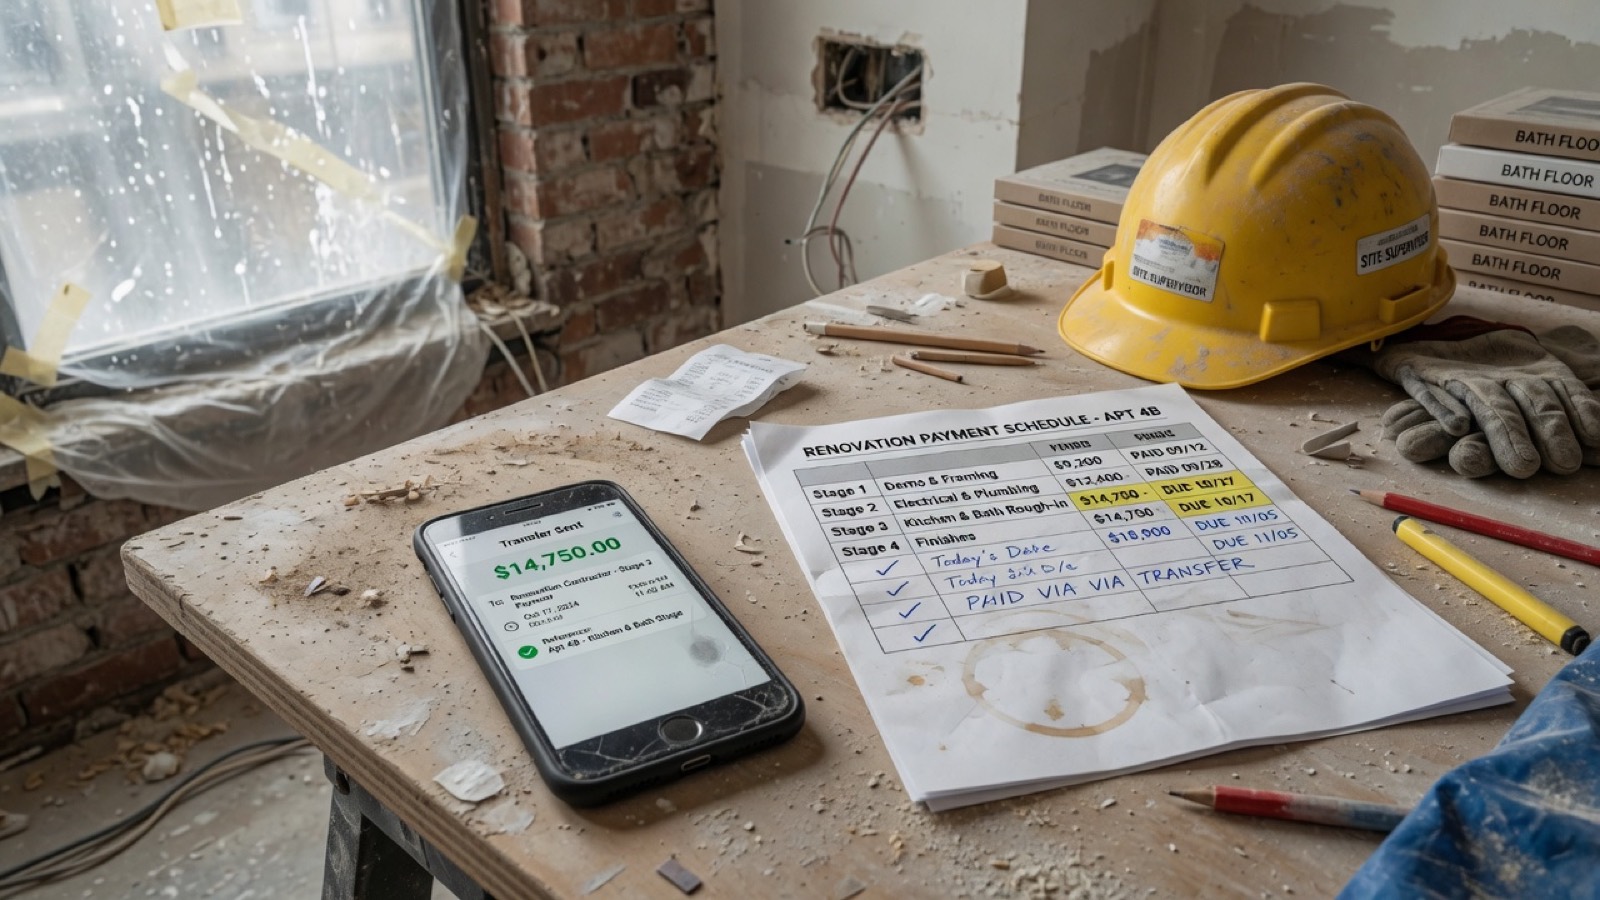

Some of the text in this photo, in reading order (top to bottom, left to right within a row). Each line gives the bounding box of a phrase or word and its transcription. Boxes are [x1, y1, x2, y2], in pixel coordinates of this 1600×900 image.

[1515, 130, 1555, 146] BATH
[1501, 164, 1595, 188] BATH FLOOR
[1489, 194, 1582, 220] BATH FLOOR
[1479, 224, 1569, 251] BATH FLOOR
[1361, 250, 1384, 268] SITE
[1472, 253, 1561, 280] BATH FLOOR
[803, 434, 917, 458] RENOVATION
[920, 425, 1000, 444] PAYMENT
[1003, 415, 1091, 435] SCHEDULE
[1104, 409, 1136, 422] APT
[1140, 405, 1162, 417] 4B
[1130, 448, 1164, 460] PAID
[941, 470, 999, 484] Framing
[1145, 463, 1180, 477] PAID
[813, 484, 867, 500] Stage 1
[894, 483, 1041, 510] Electrical & Plumbing
[821, 502, 879, 518] Stage 2
[1178, 492, 1255, 513] DUE 10/17
[903, 513, 957, 528] Kitchen
[960, 510, 970, 521] &
[972, 506, 1005, 520] Bath
[1195, 518, 1231, 532] DUE
[499, 530, 552, 549] Transfer
[554, 520, 585, 535] Sent
[831, 520, 889, 537] Stage 3
[915, 532, 977, 548] Finishes
[1212, 527, 1299, 550] DUE 11/05
[494, 536, 622, 580] $14,750.00
[841, 540, 900, 557] Stage 4
[944, 572, 996, 590] Today
[966, 556, 1256, 611] PAID VIA VIA TRANSFER
